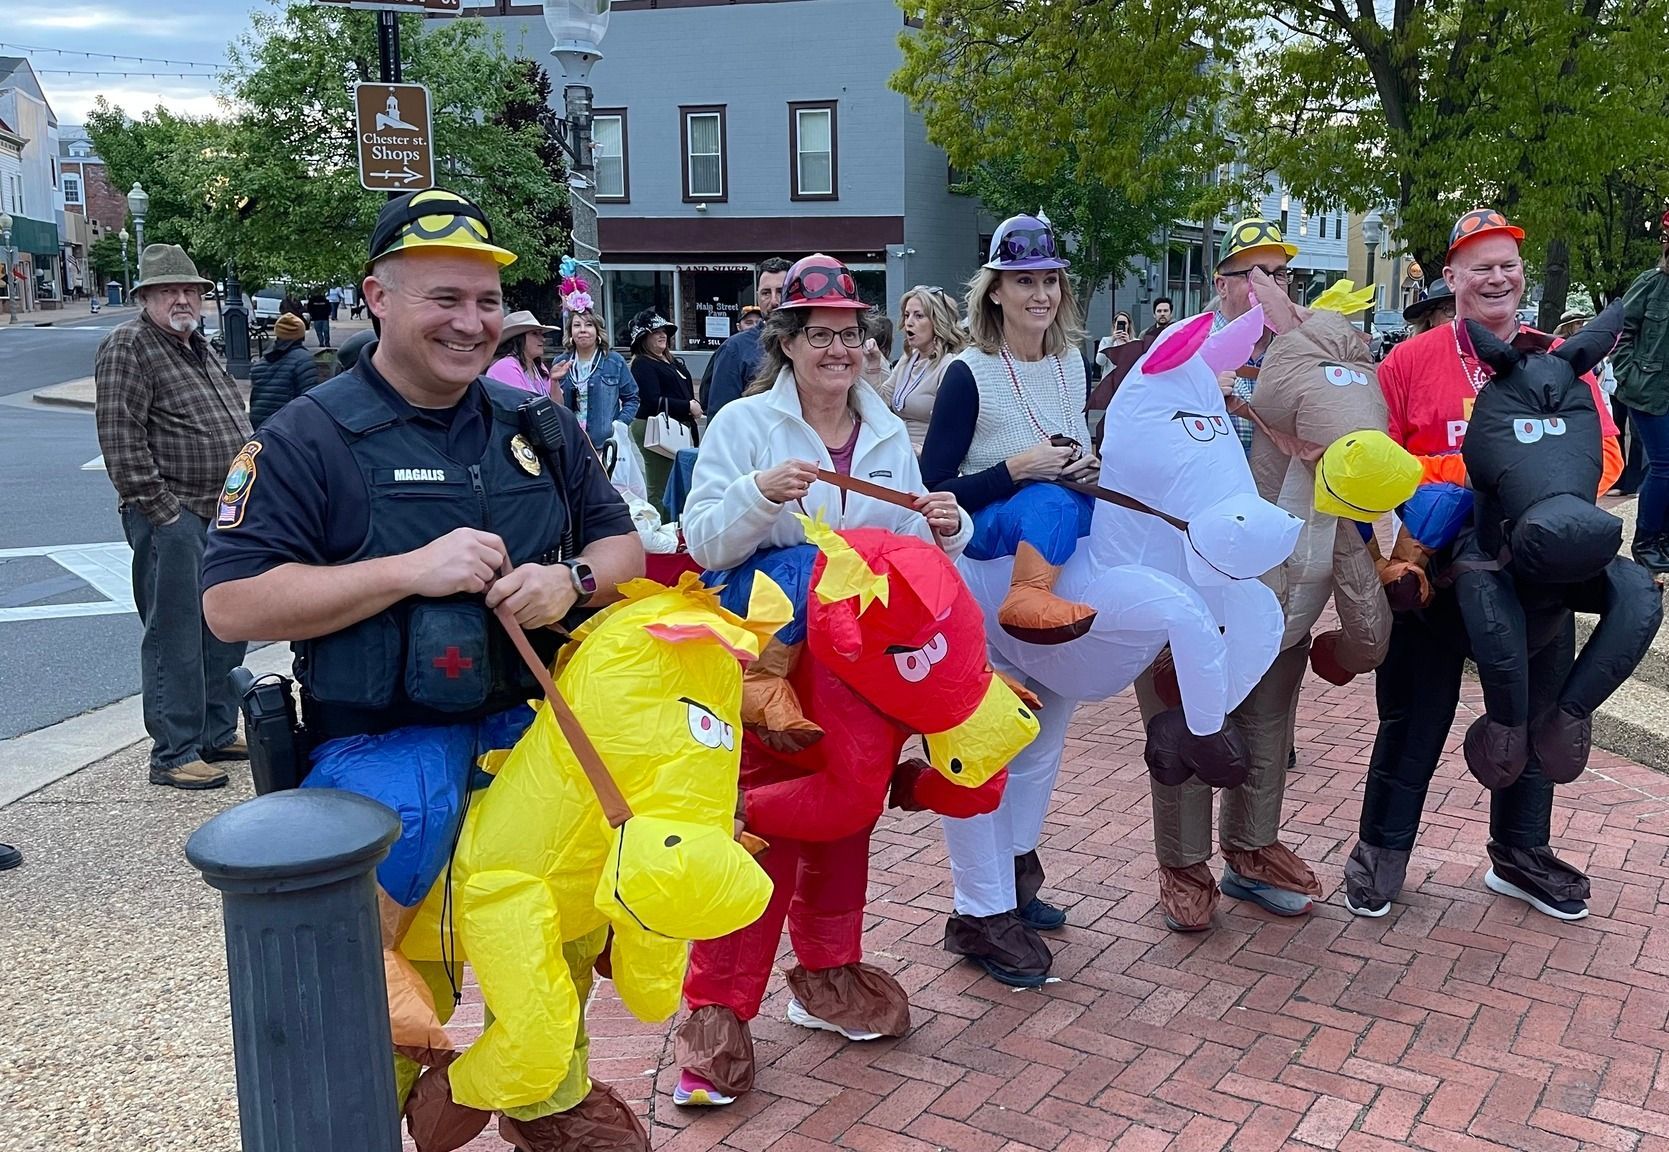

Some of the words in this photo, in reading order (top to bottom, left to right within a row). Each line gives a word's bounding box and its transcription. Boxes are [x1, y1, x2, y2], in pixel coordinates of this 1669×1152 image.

[362, 132, 409, 145] Chester
[412, 136, 427, 146] st.
[371, 145, 420, 165] Shops
[696, 302, 714, 311] Main
[716, 303, 739, 311] Street
[394, 468, 445, 481] MAGALIS
